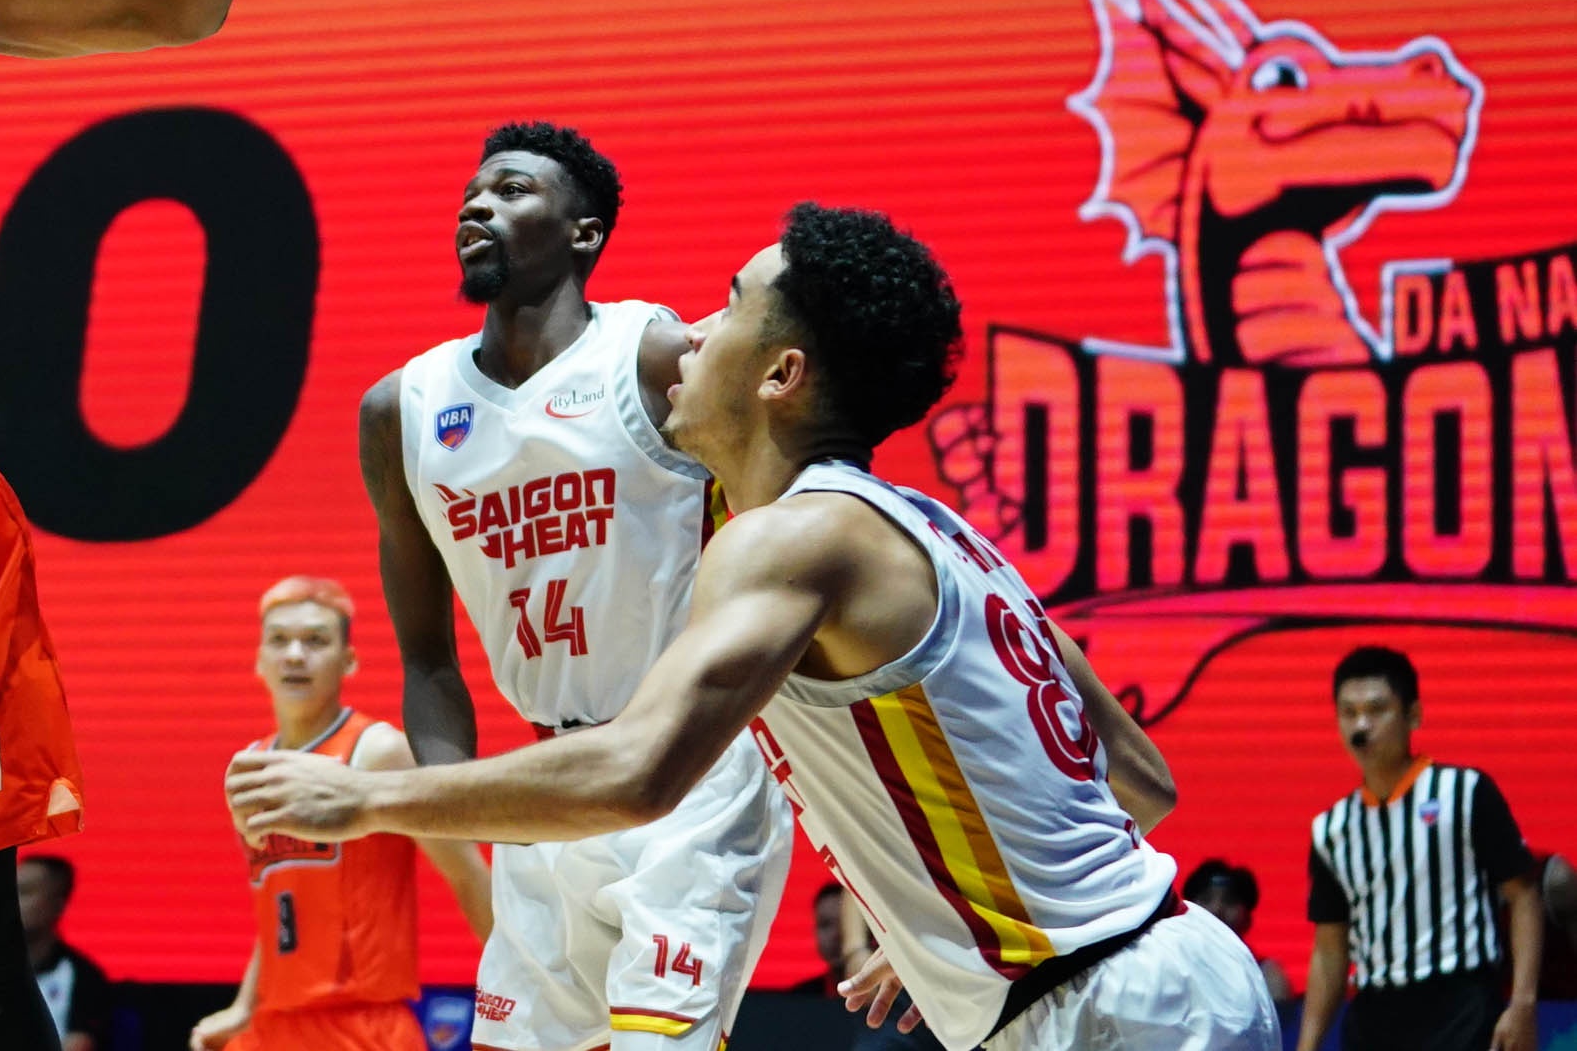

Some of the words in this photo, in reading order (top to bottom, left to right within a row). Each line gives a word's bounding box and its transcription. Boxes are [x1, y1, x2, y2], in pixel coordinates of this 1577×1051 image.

[1394, 269, 1478, 356] DA
[1495, 253, 1577, 343] NA
[440, 407, 470, 428] VBA
[993, 334, 1577, 591] DRAGON
[444, 466, 616, 542] SAIGON
[497, 508, 615, 569] HEAT
[509, 579, 589, 661] 14
[652, 935, 703, 987] 14
